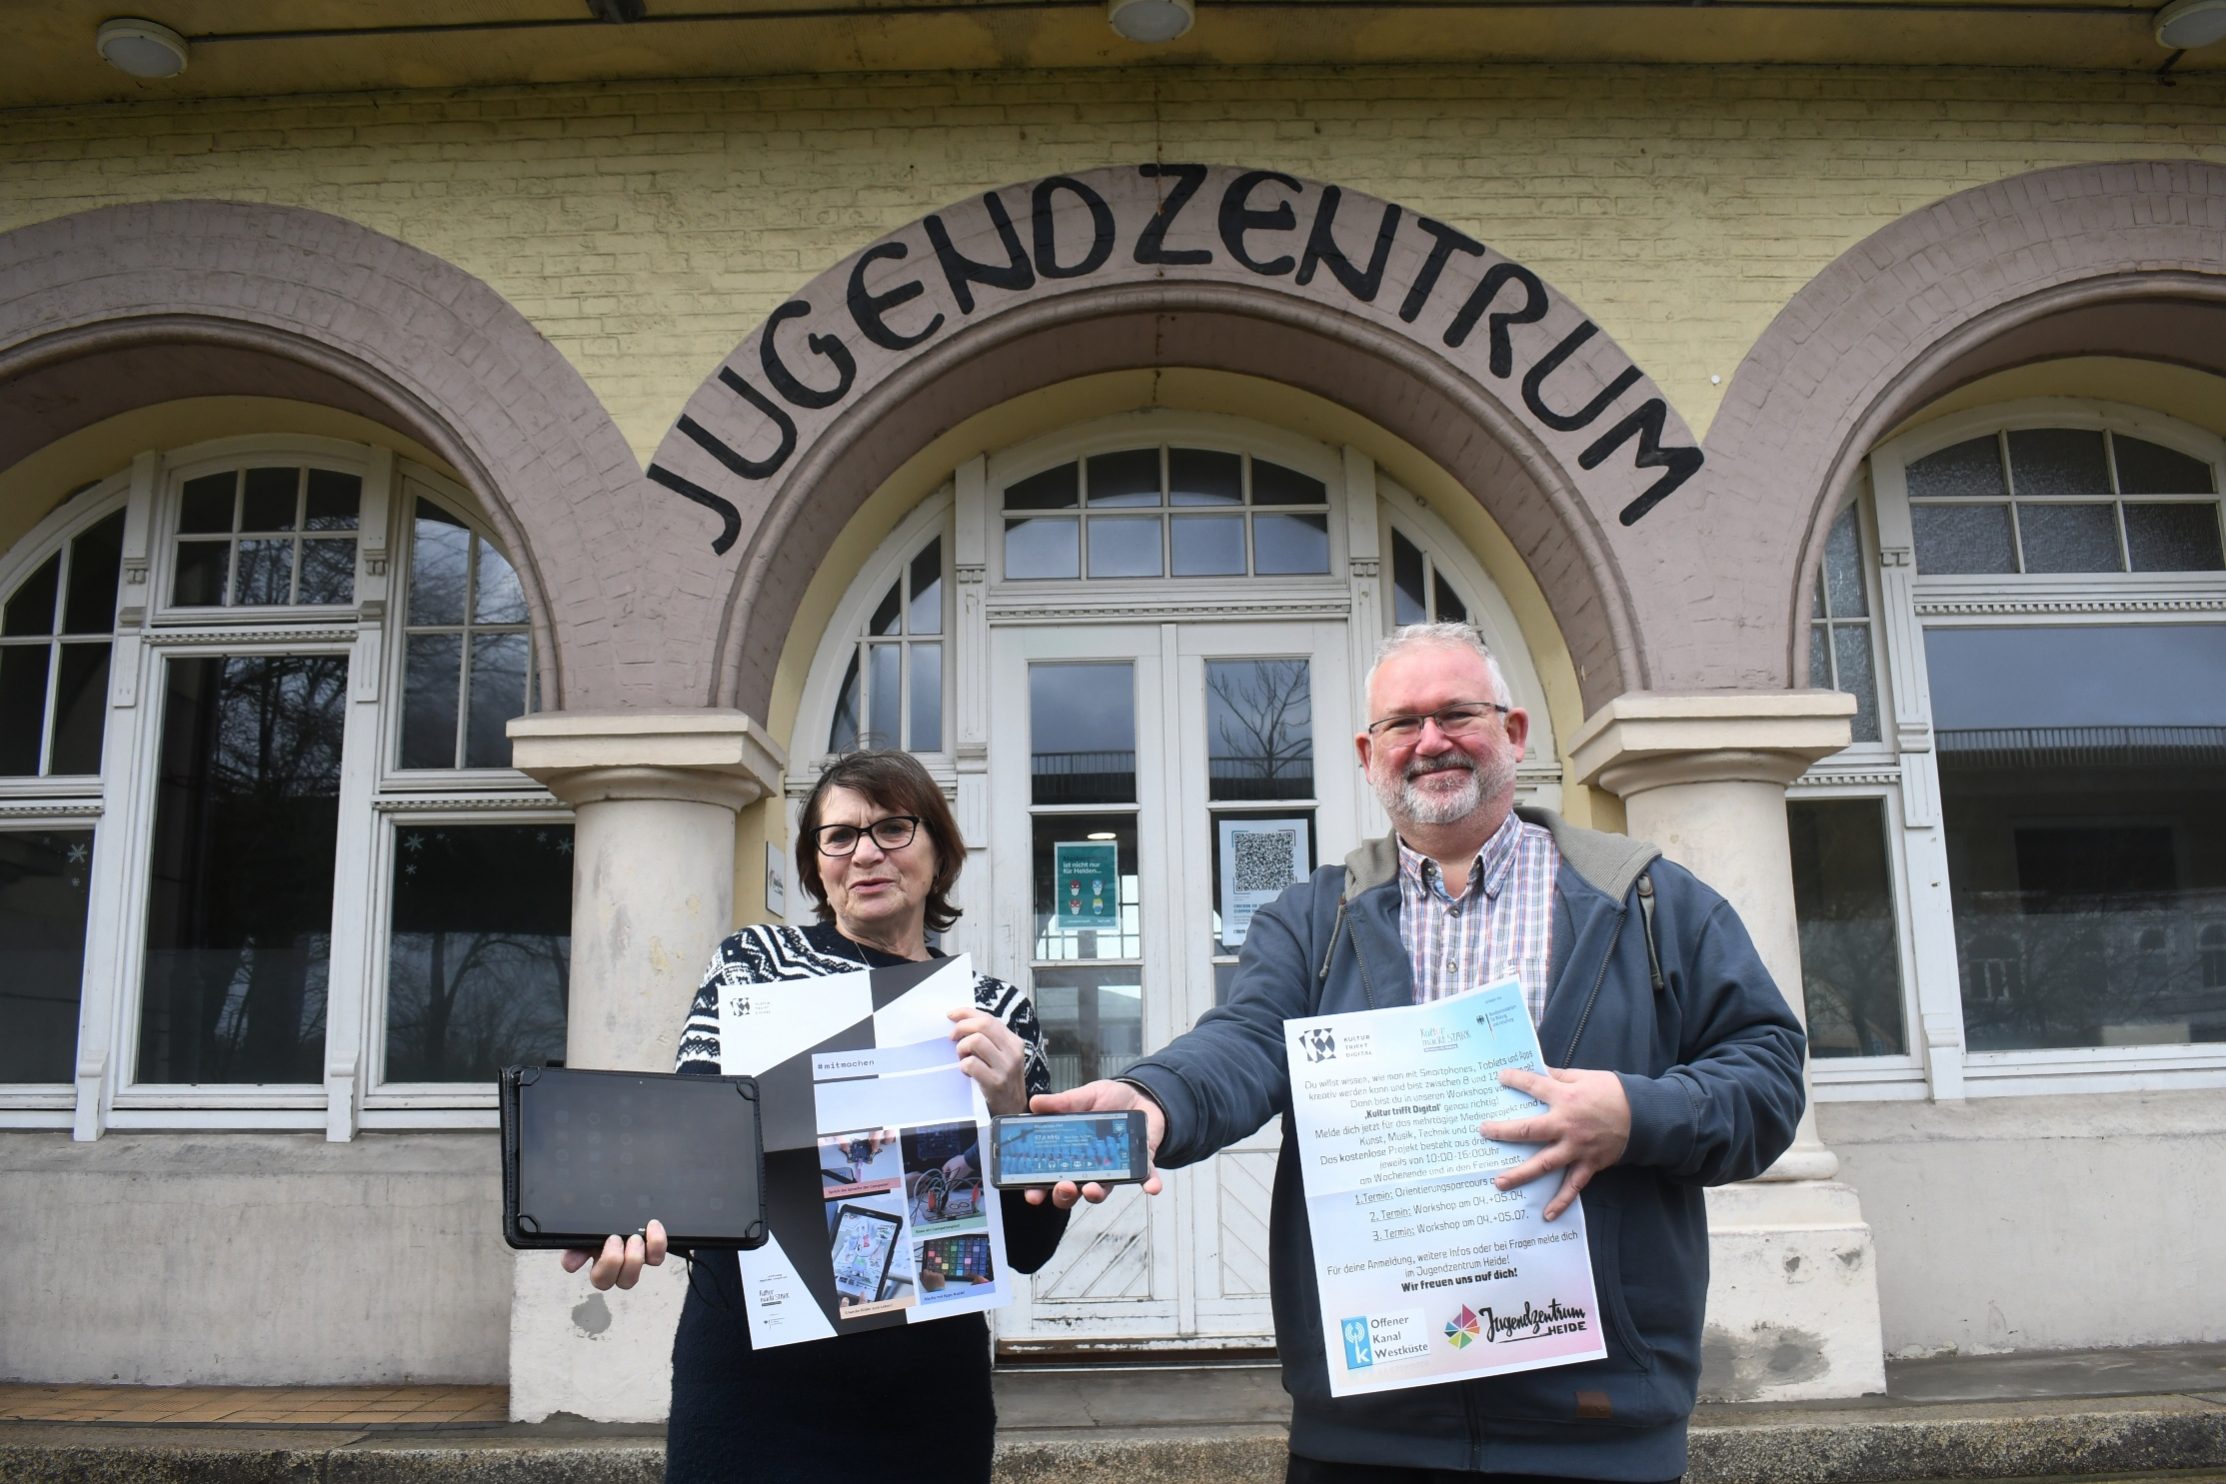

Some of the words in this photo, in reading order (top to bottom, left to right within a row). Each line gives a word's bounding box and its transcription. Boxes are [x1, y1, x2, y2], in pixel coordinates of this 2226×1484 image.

[646, 163, 1704, 555] JUGENDZENTRUM
[1304, 1080, 1317, 1090] Du
[1372, 1074, 1385, 1082] wie
[1386, 1072, 1404, 1080] man
[1478, 1058, 1508, 1070] Tablets
[1508, 1052, 1518, 1062] und
[1308, 1092, 1336, 1100] kreativ
[1339, 1088, 1367, 1097] werden
[1369, 1086, 1388, 1094] kann
[1391, 1083, 1406, 1092] und
[1407, 1081, 1422, 1090] bist
[1425, 1078, 1461, 1088] zwischen
[1472, 1075, 1486, 1084] und
[1350, 1099, 1373, 1108] Dann
[1374, 1098, 1390, 1106] bist
[1392, 1096, 1402, 1104] du
[1414, 1092, 1445, 1101] unseren
[1446, 1086, 1492, 1098] Workshops
[1314, 1128, 1341, 1138] Melde
[1343, 1125, 1360, 1134] dich
[1361, 1123, 1380, 1134] jetzt
[1382, 1120, 1393, 1129] für
[1396, 1119, 1411, 1127] das
[1413, 1114, 1458, 1125] mehrtägige
[1460, 1104, 1518, 1121] Medienprojekt
[1519, 1098, 1538, 1108] rund
[1392, 1106, 1411, 1116] trifft
[1444, 1102, 1469, 1112] genau
[1418, 1126, 1449, 1138] Technik
[1452, 1125, 1467, 1135] und
[1320, 1156, 1338, 1165] Das
[1339, 1149, 1386, 1162] kostenlose
[1388, 1144, 1418, 1154] Projekt
[1420, 1140, 1453, 1150] besteht
[1455, 1139, 1470, 1148] aus
[1380, 1158, 1407, 1170] jeweils
[1409, 1156, 1424, 1165] von
[1360, 1177, 1372, 1185] am
[1374, 1169, 1427, 1182] Wochenende
[1429, 1167, 1444, 1176] und
[1447, 1165, 1454, 1173] in
[1456, 1162, 1471, 1172] den
[1473, 1158, 1499, 1169] Ferien
[1395, 1178, 1488, 1197] Orientierungsparcours
[1369, 1212, 1379, 1222] 2.
[1381, 1208, 1412, 1220] Termin:
[1413, 1202, 1456, 1214] Workshop
[1459, 1200, 1471, 1208] am
[1372, 1230, 1382, 1241] 3.
[1384, 1227, 1415, 1240] Termin:
[1417, 1221, 1460, 1234] Workshop
[1462, 1219, 1475, 1227] am
[1327, 1265, 1341, 1276] Für
[1343, 1262, 1366, 1274] deine
[1368, 1256, 1416, 1270] Anmeldung,
[1417, 1250, 1447, 1262] weitere
[1449, 1247, 1471, 1257] Infos
[1473, 1244, 1492, 1254] oder
[1494, 1240, 1508, 1251] bei
[1509, 1238, 1536, 1250] Fragen
[1537, 1234, 1560, 1245] melde
[1561, 1230, 1578, 1241] dich
[1405, 1268, 1415, 1278] im
[1416, 1261, 1481, 1277] Jugendzentrum
[1483, 1255, 1510, 1267] Heide!
[1401, 1282, 1419, 1292] Wir
[1420, 1278, 1454, 1290] freuen
[1456, 1276, 1473, 1285] uns
[1475, 1272, 1492, 1282] auf
[1494, 1268, 1518, 1280] dich!
[1370, 1317, 1409, 1329] Offener
[1478, 1298, 1586, 1342] Jugendzentrum
[1548, 1321, 1587, 1335] HEIDE
[1372, 1331, 1402, 1344] Kanal
[1374, 1344, 1428, 1359] Westküste
